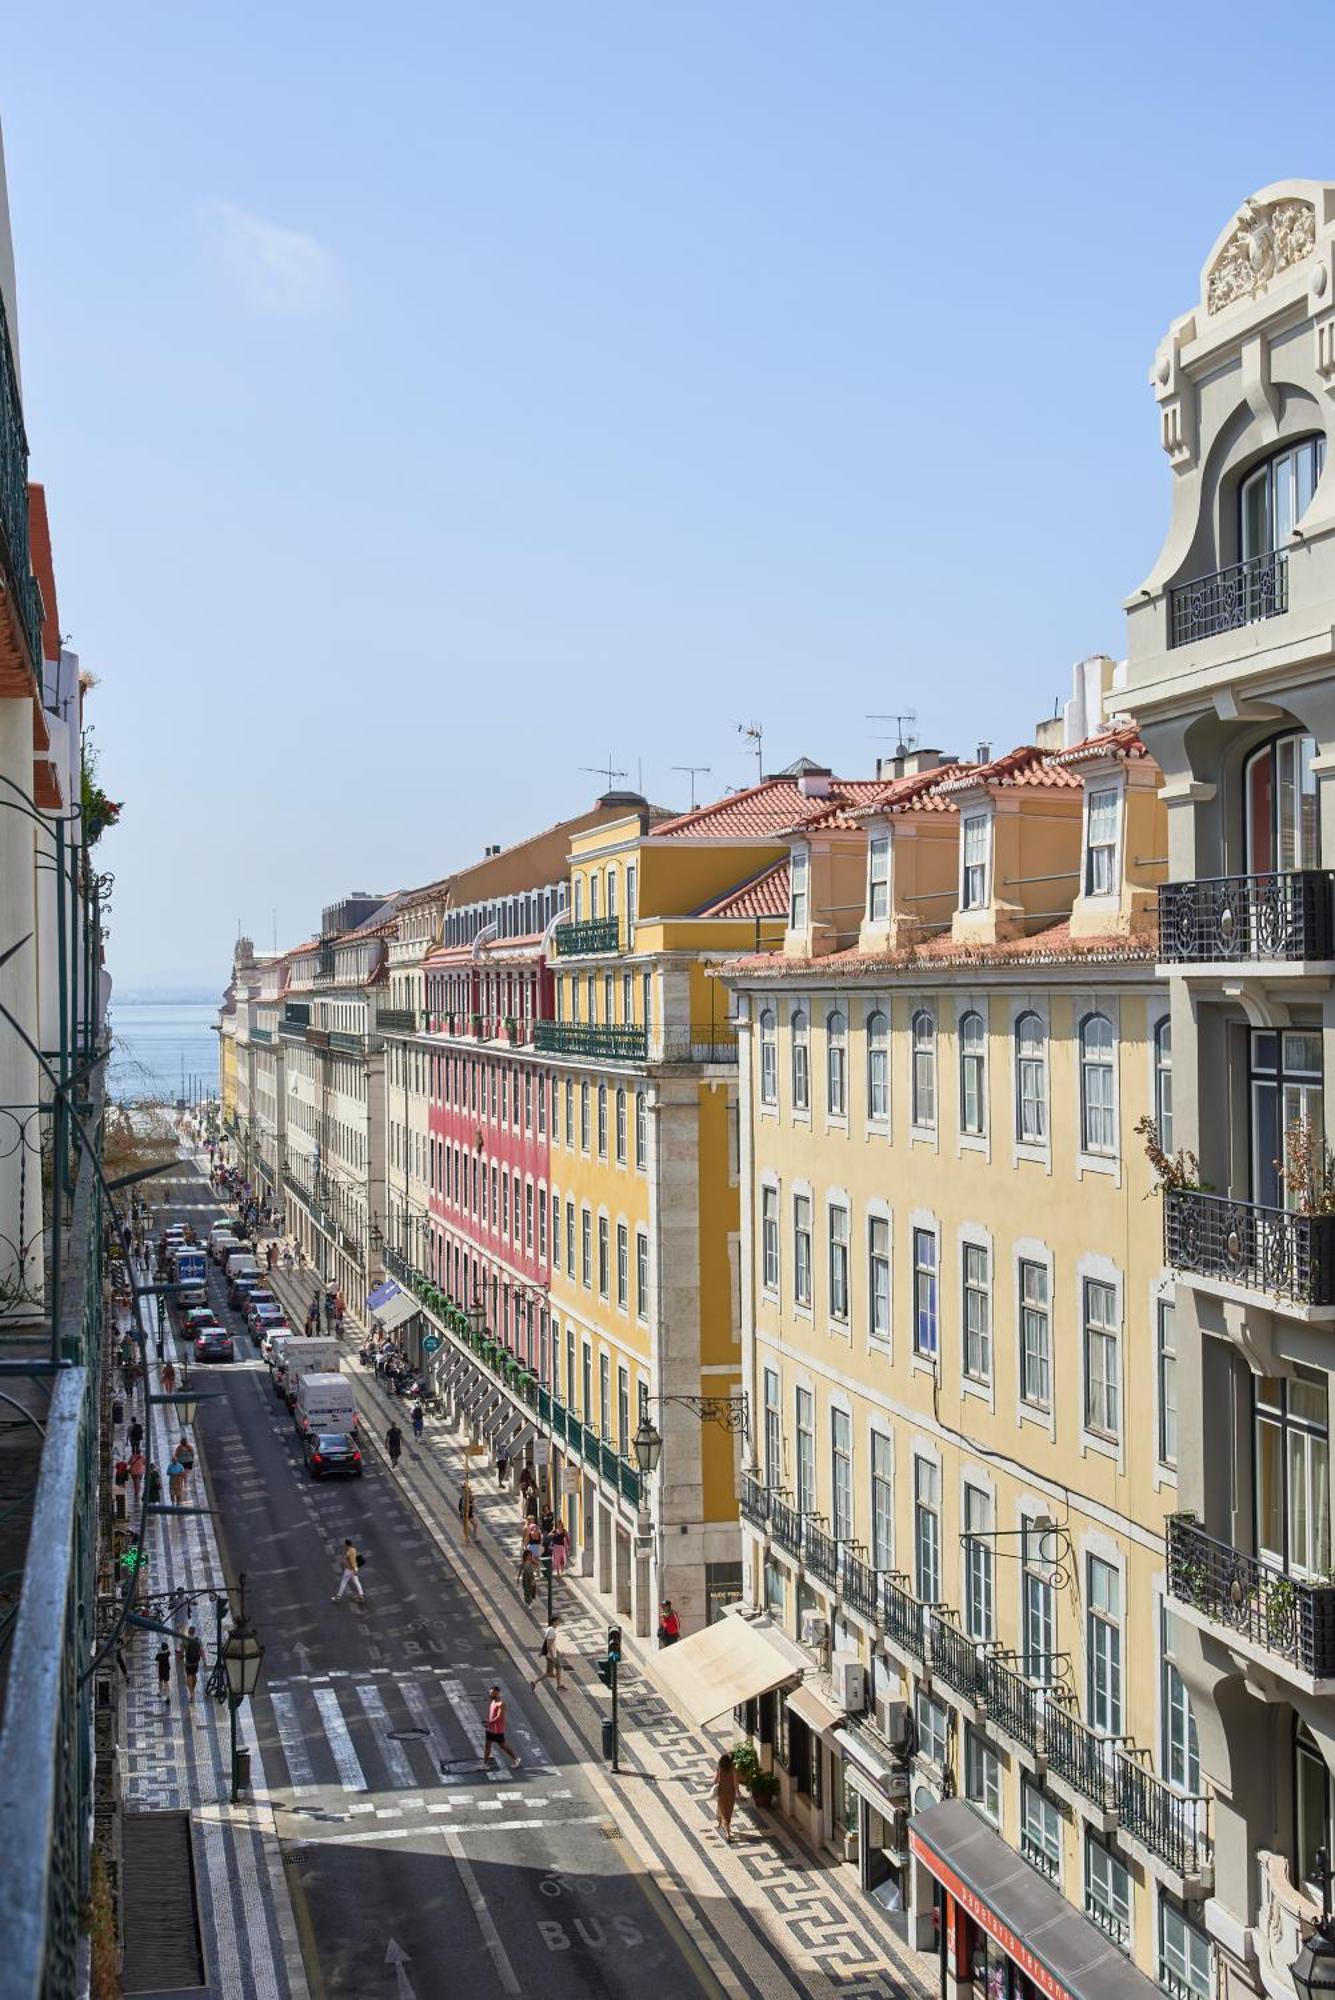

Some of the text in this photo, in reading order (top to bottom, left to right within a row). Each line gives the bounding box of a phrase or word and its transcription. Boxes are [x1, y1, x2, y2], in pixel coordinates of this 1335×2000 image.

[403, 1638, 473, 1655] BUS
[536, 1915, 645, 1951] BUS
[962, 1887, 1015, 1950] papelaria
